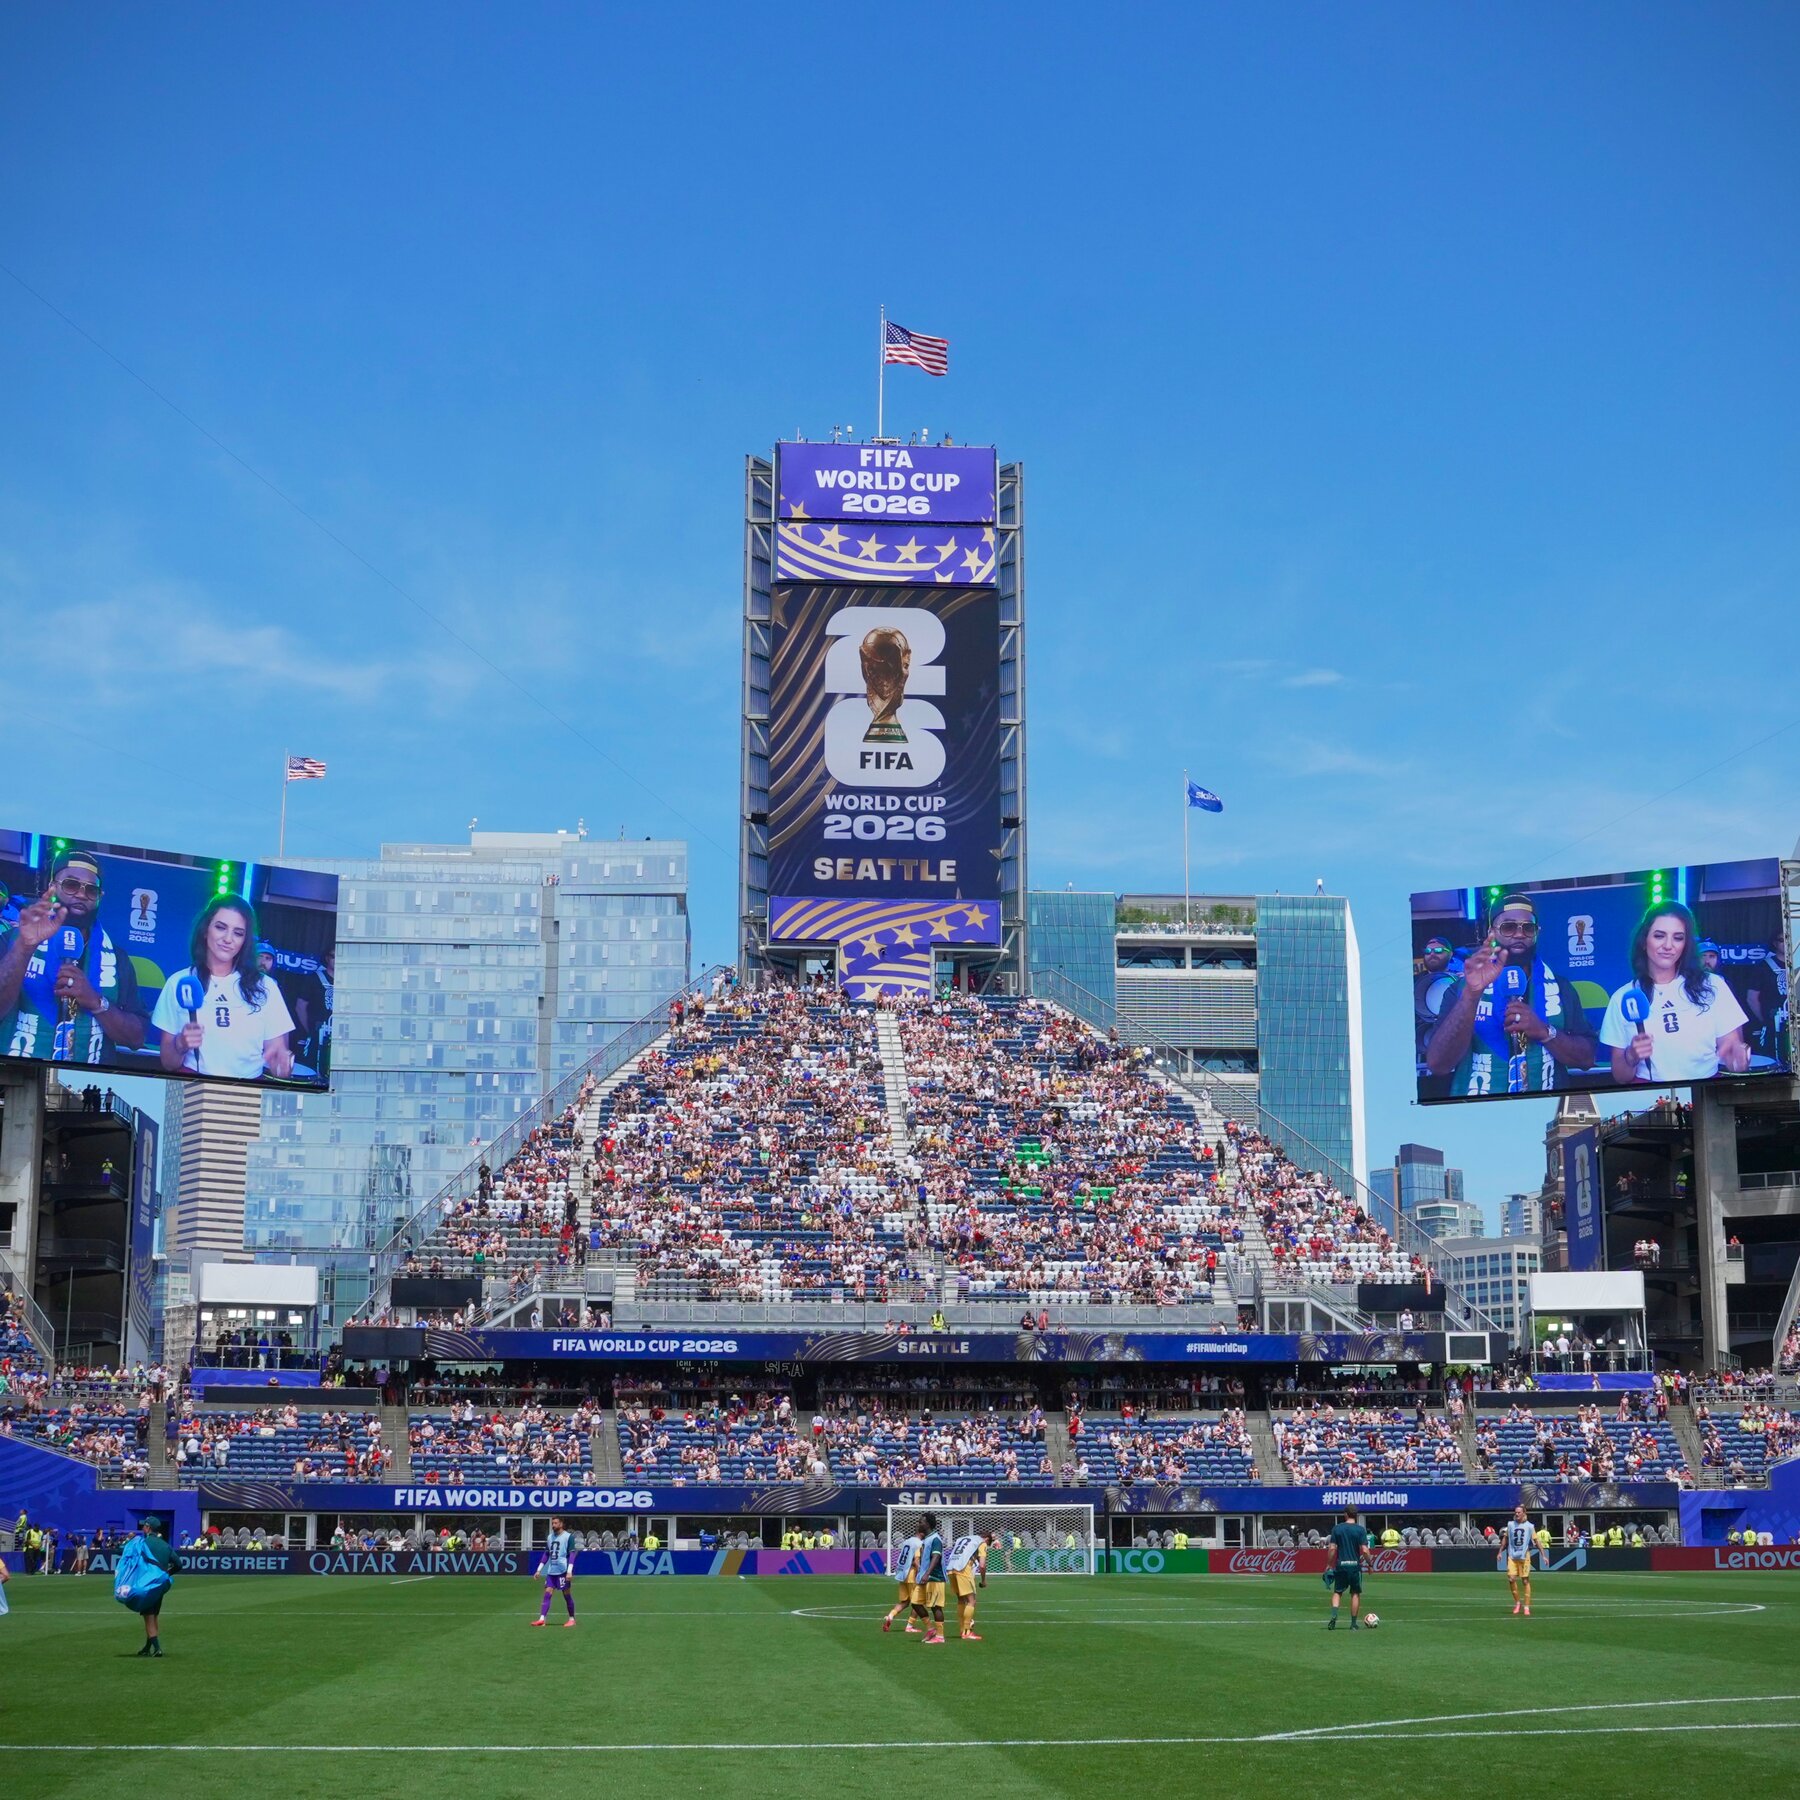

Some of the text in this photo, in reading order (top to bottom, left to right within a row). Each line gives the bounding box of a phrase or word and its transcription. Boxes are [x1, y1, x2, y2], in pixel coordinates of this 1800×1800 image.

[860, 449, 913, 468] FIFA
[815, 470, 960, 492] WORLD CUP
[842, 493, 930, 514] 2026
[859, 751, 914, 770] FIFA
[825, 794, 947, 812] WORLD CUP
[823, 814, 947, 841] 2026
[813, 857, 956, 882] SEATTLE
[129, 934, 155, 944] 2026
[553, 1339, 738, 1353] FIFA WORLD CUP 2026
[897, 1341, 969, 1354] SEATTLE
[1186, 1342, 1248, 1355] #FIFAWorldCup
[394, 1488, 653, 1508] FIFA WORLD CUP 2026
[898, 1491, 998, 1505] SEATTLE
[1322, 1490, 1408, 1507] #FIFAWorldCup
[309, 1552, 518, 1575] QATAR AIRWAYS
[602, 1551, 675, 1575] VISA
[1229, 1550, 1299, 1573] Coca-Cola
[1714, 1547, 1800, 1568] Lenovo
